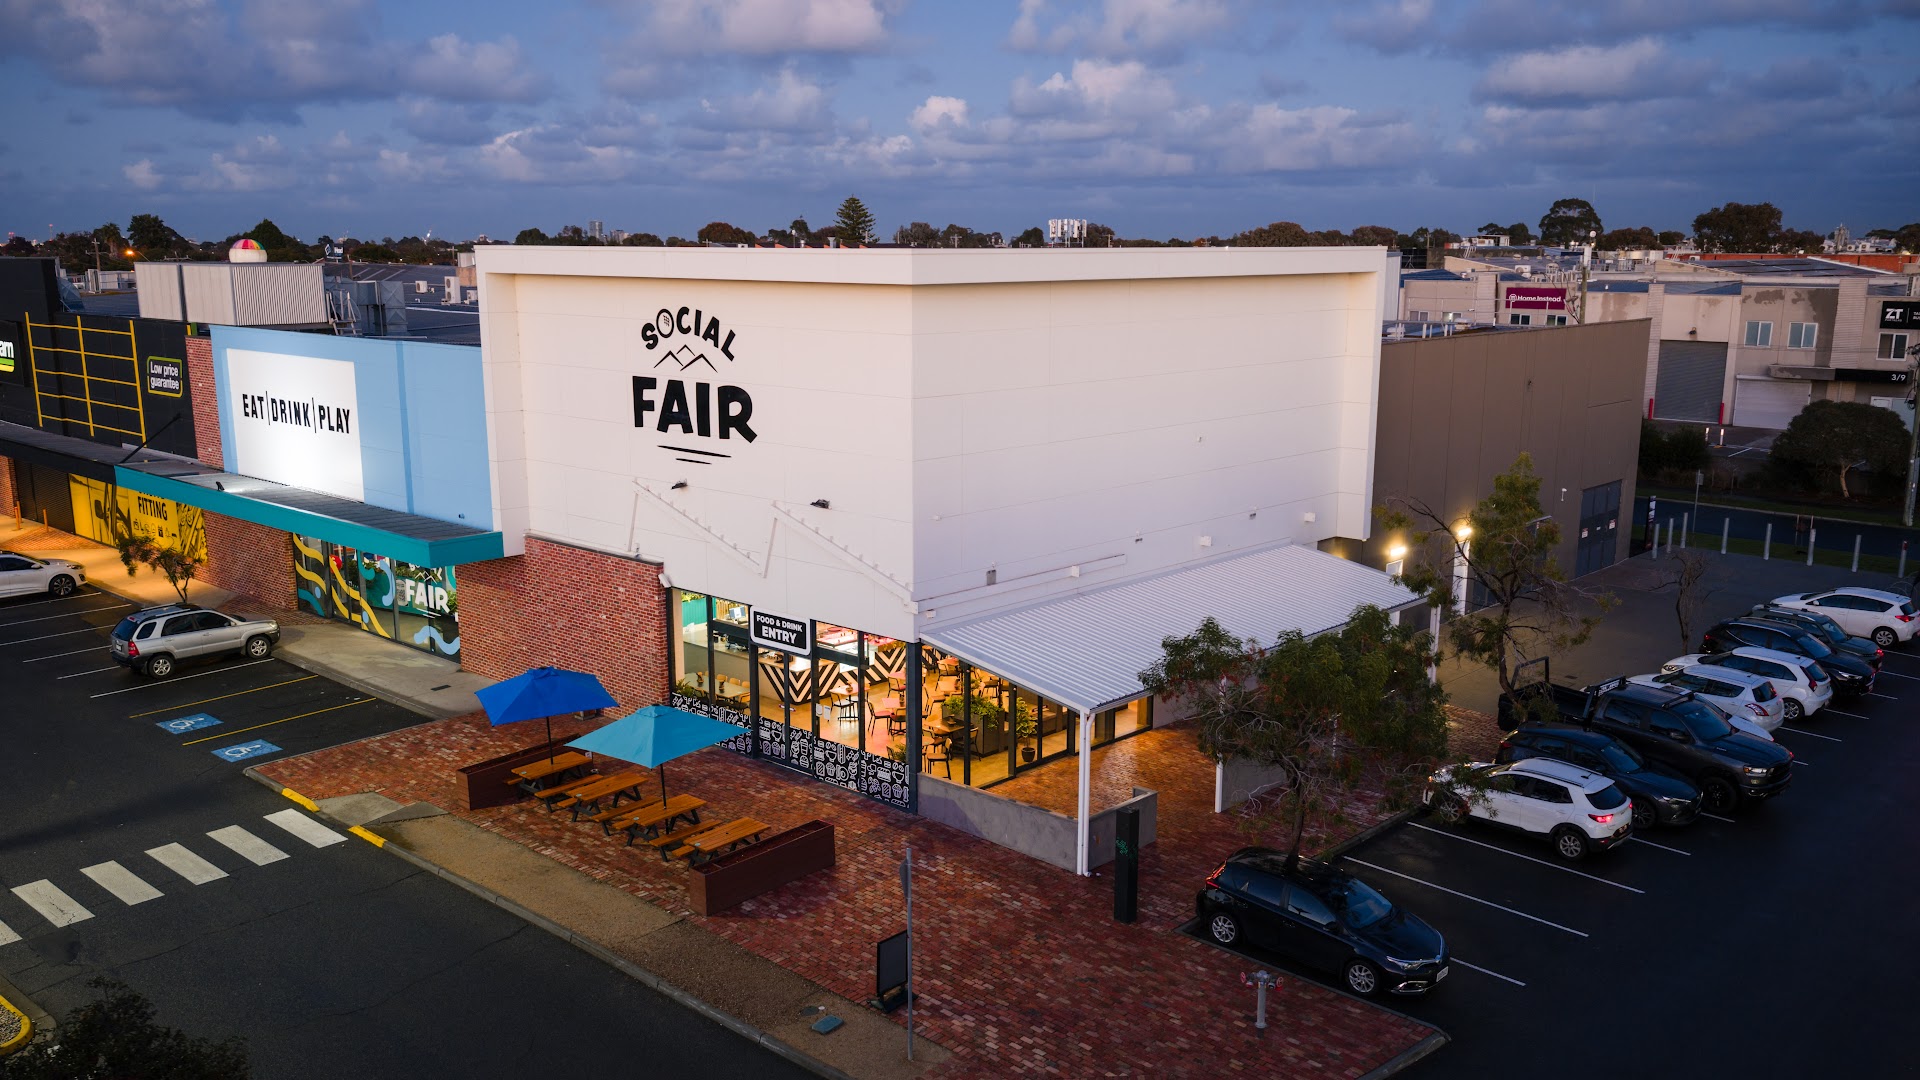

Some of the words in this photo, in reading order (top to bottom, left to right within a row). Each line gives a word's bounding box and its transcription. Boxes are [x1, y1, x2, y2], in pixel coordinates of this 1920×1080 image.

[1885, 309, 1903, 319] ZT
[641, 306, 736, 362] SOCIAL
[151, 361, 162, 374] Low
[163, 364, 178, 377] price
[1891, 373, 1906, 381] 3/9
[151, 377, 179, 389] guarantee
[242, 393, 264, 420] EAT
[270, 397, 311, 428] DRINK
[318, 404, 350, 434] PLAY
[632, 375, 758, 443] FAIR
[137, 496, 168, 521] FITTING
[405, 578, 450, 614] FAIR
[756, 615, 774, 625] FOOD
[782, 621, 802, 632] DRINK
[762, 626, 796, 644] ENTRY
